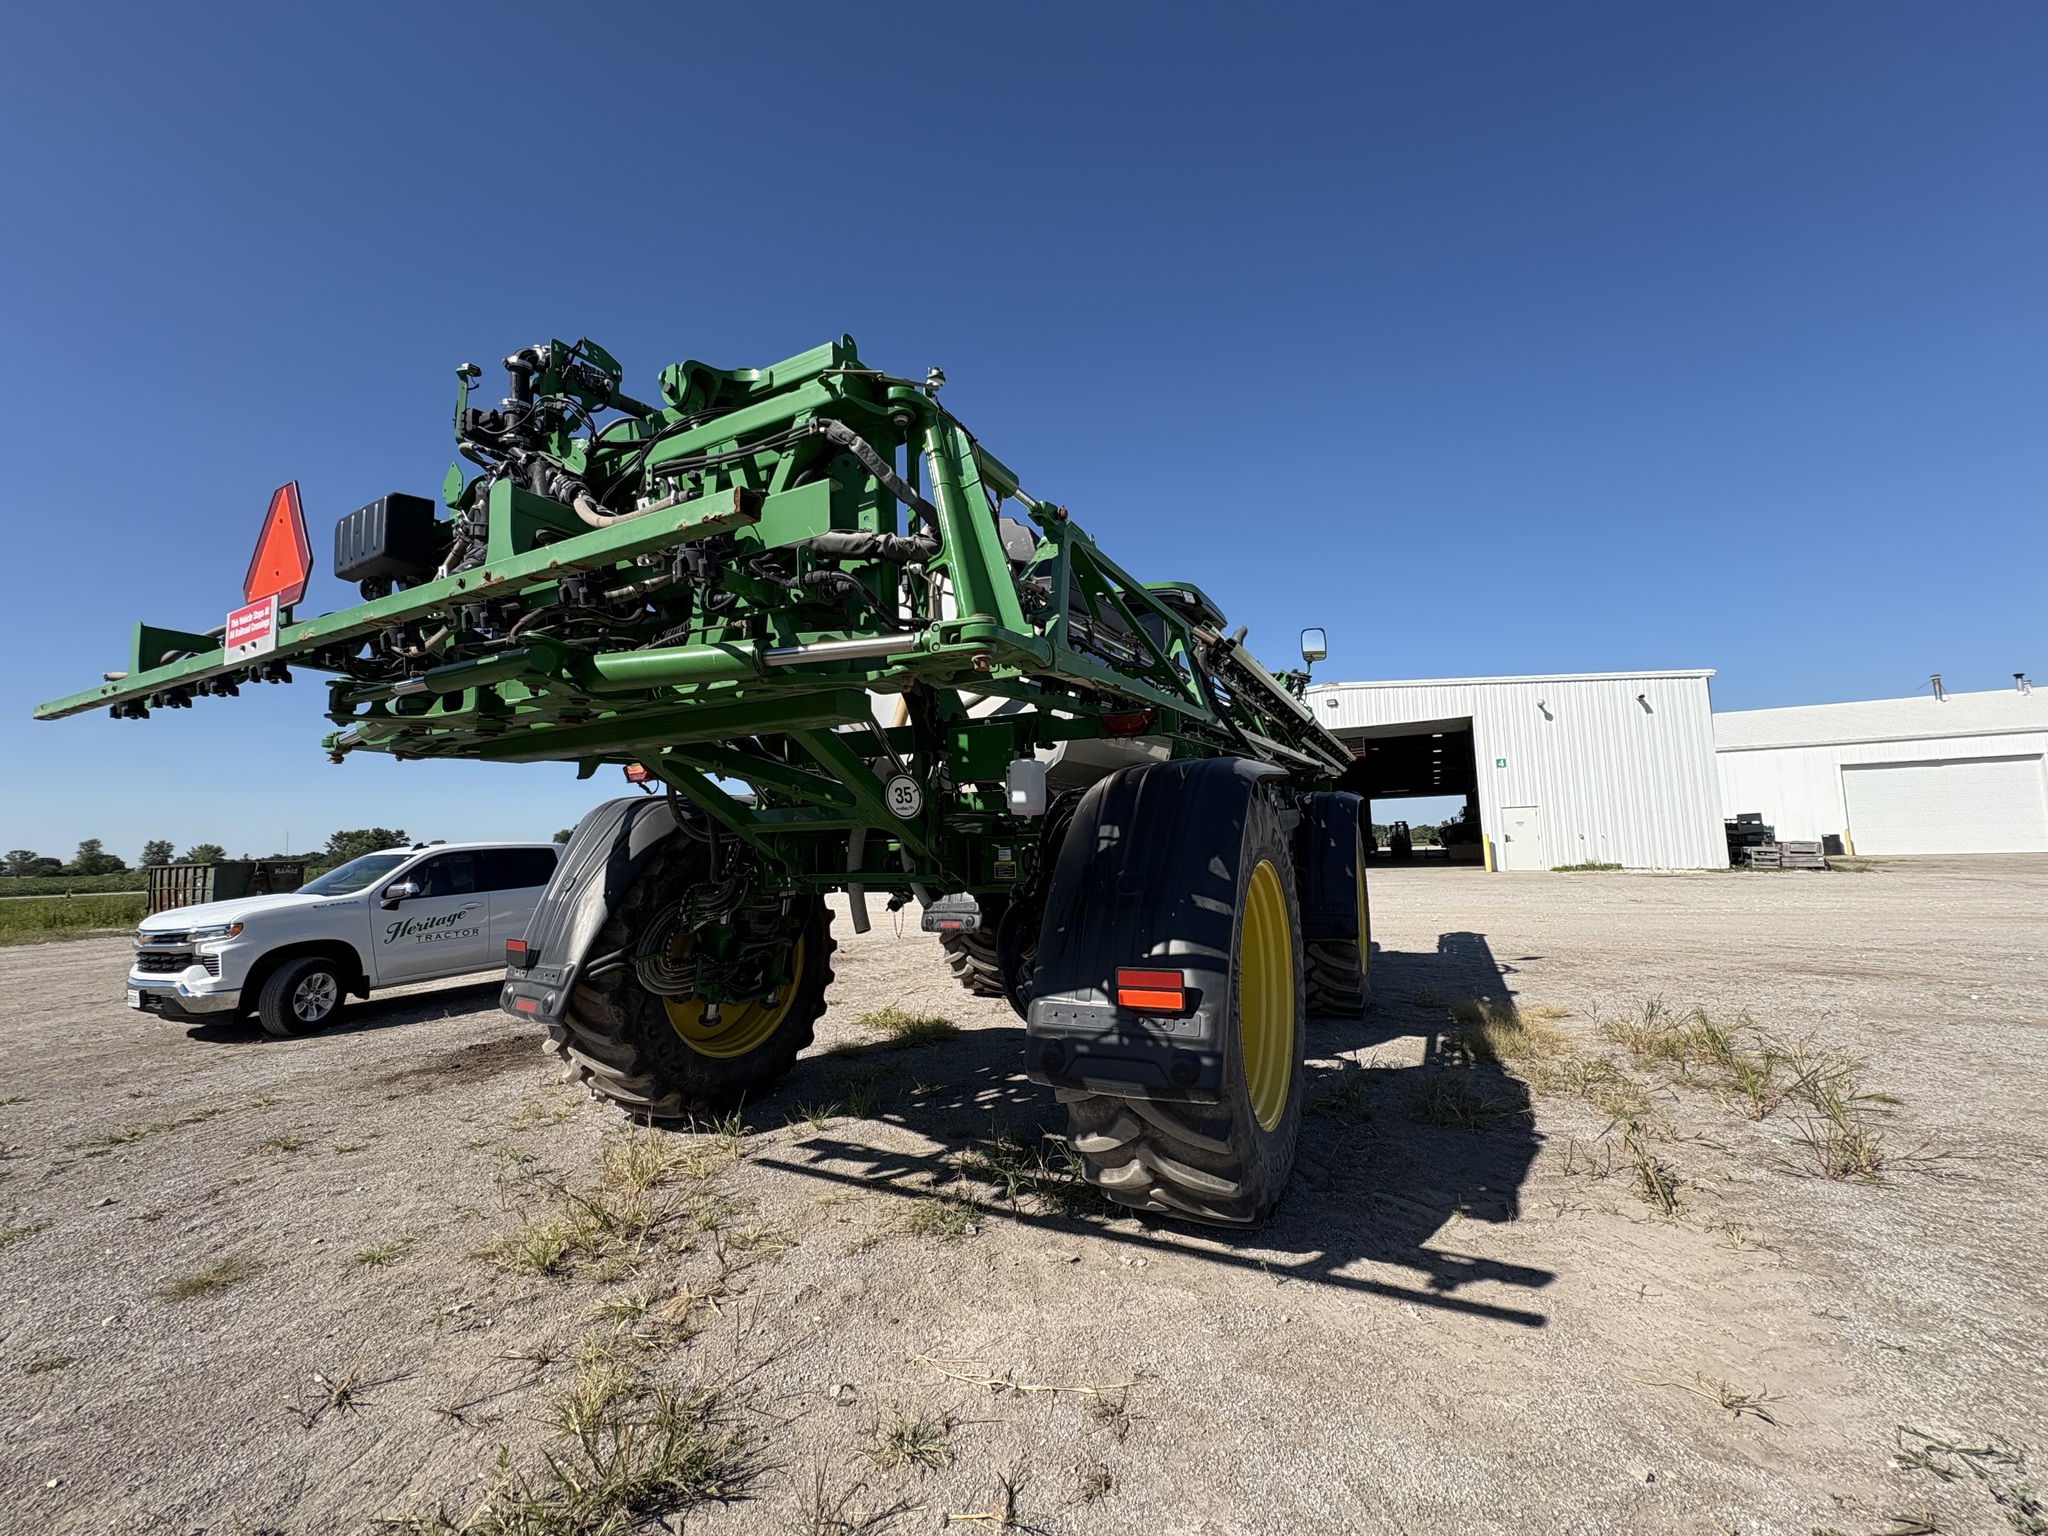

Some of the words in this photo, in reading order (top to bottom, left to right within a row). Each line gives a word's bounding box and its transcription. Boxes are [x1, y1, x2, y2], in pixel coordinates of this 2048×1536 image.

[894, 786, 912, 804] 35
[384, 910, 467, 944] Heritage
[416, 929, 480, 942] TRACTOR
